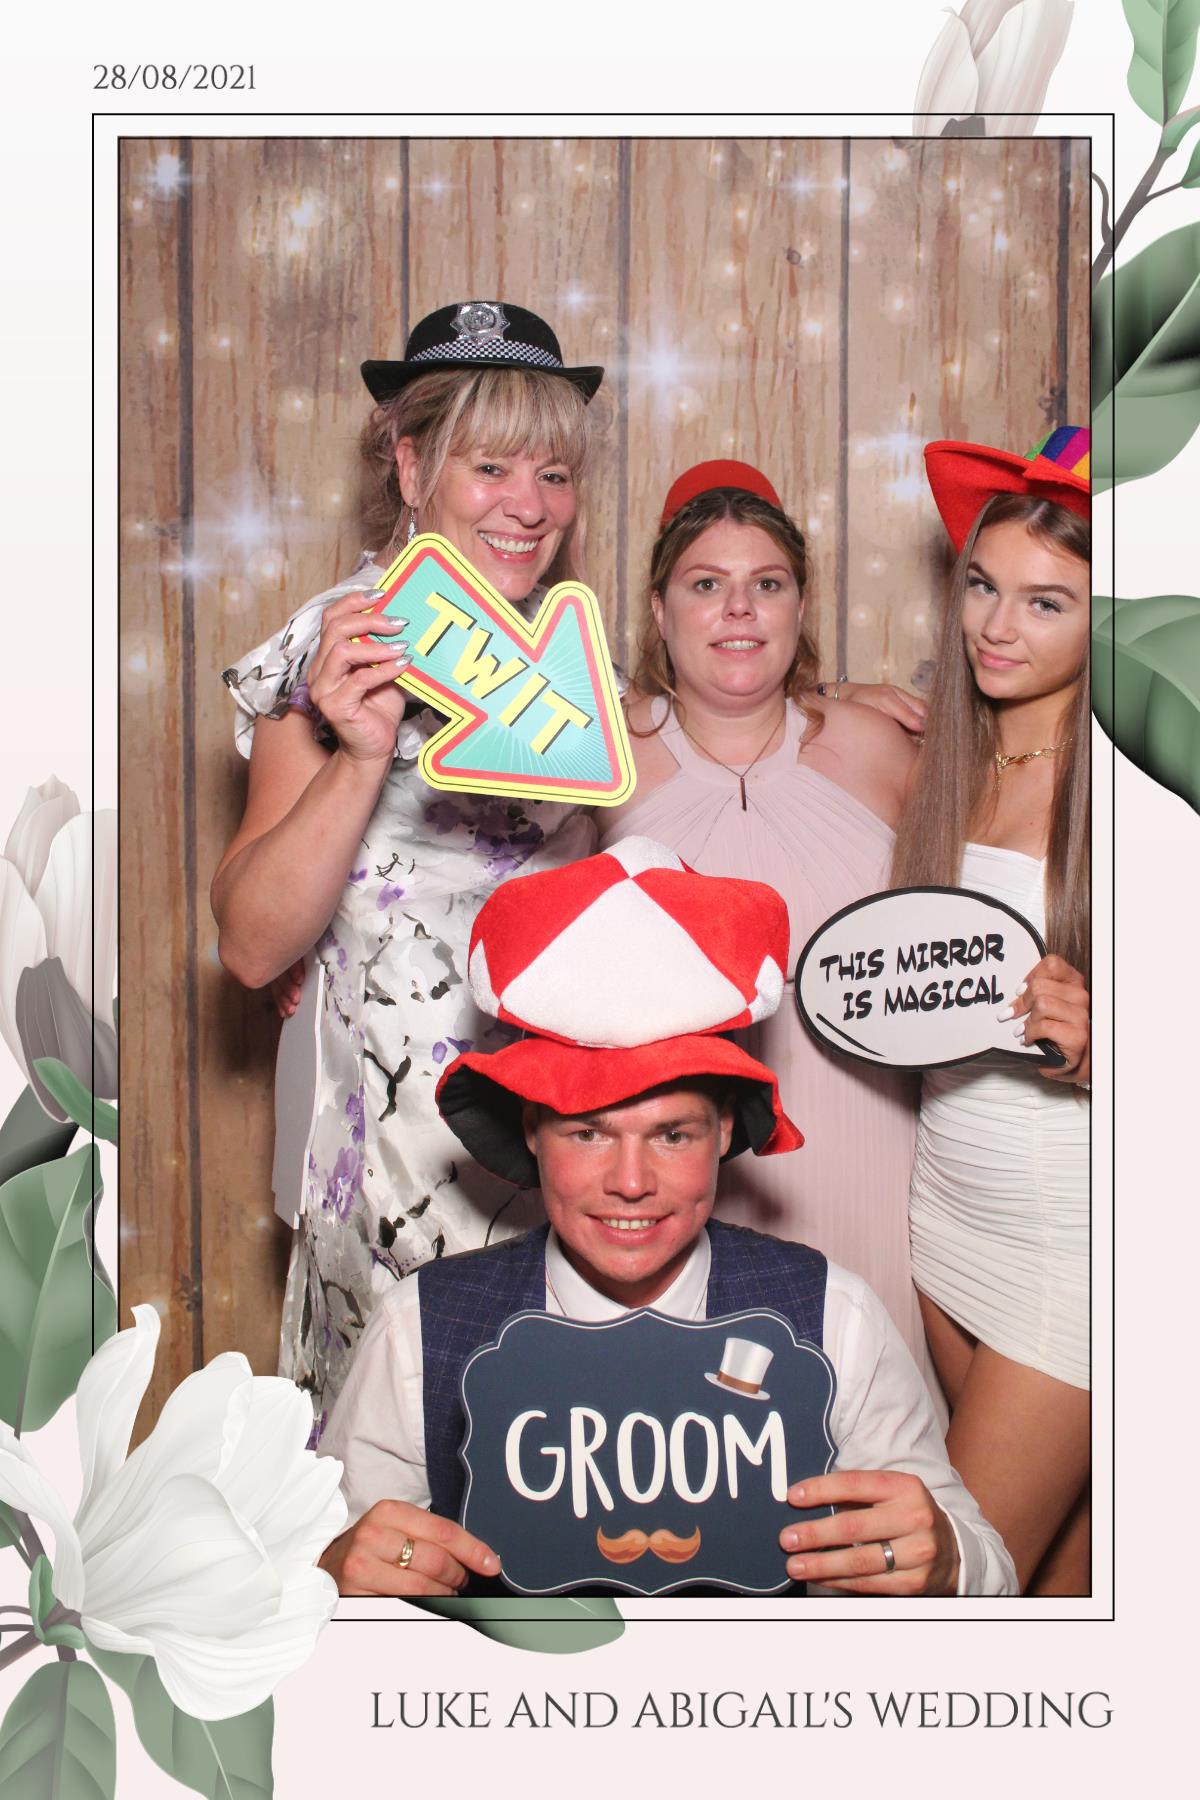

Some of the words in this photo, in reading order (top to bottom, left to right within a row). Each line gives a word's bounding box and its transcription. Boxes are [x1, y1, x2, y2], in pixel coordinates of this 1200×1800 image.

[414, 592, 594, 755] TWIT
[819, 948, 885, 983] THIS
[897, 933, 1005, 975] MIRROR
[843, 990, 873, 1021] IS
[884, 974, 1004, 1016] MAGICAL
[505, 1406, 788, 1519] GROOM
